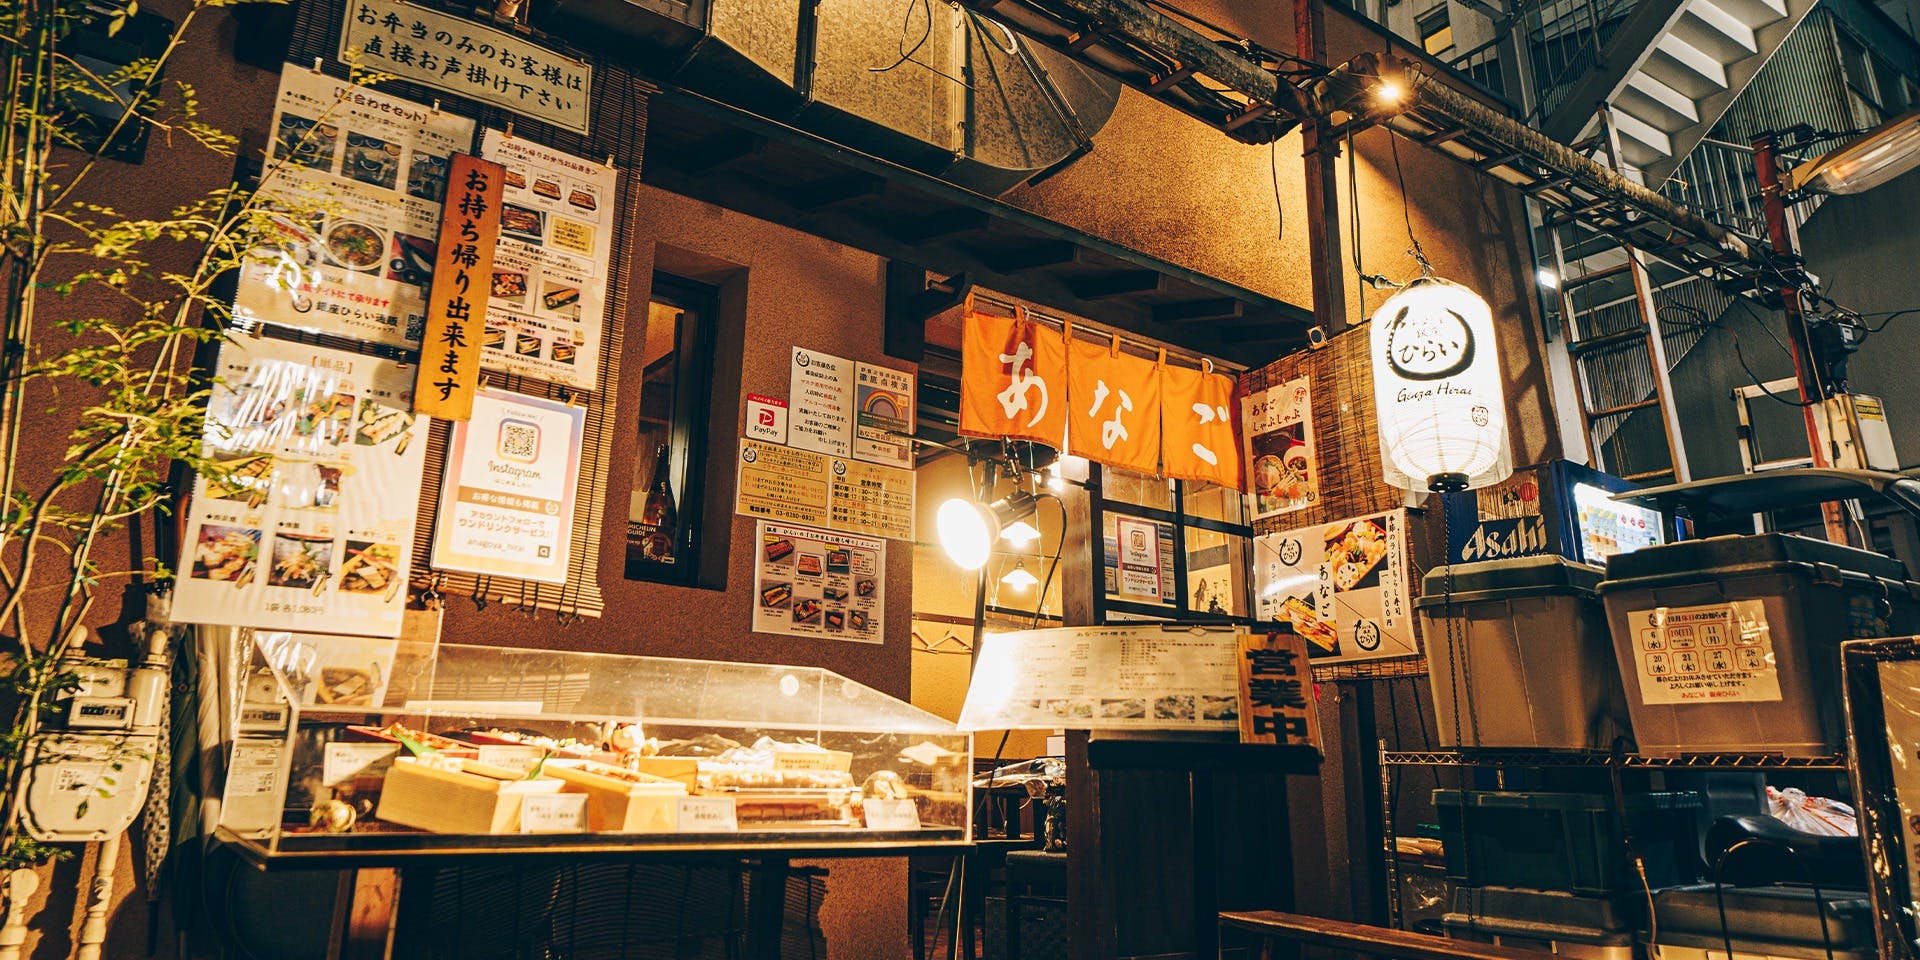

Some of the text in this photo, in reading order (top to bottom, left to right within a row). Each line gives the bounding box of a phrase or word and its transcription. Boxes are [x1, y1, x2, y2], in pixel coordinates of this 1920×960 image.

[357, 4, 582, 92] お弁当のみのお客様は
[363, 35, 573, 111] 直接お声掛け下さい
[433, 168, 488, 401] お持ち帰り出来ます
[298, 283, 390, 307] 販サイトにて承ります
[316, 301, 398, 327] 銀座ひらい通販
[1399, 340, 1459, 364] ひらい
[811, 360, 836, 371] お客様各位
[1396, 382, 1473, 403] Ginza Hirai
[997, 342, 1230, 466] あなご
[1252, 398, 1276, 417] あなご
[1253, 408, 1301, 432] しゃぶしゃぶ
[754, 425, 778, 437] PayPay
[488, 460, 542, 480] Instagram
[860, 480, 882, 489] 営業時間
[470, 510, 546, 527] アカウントフォローで
[627, 523, 657, 533] MICHELIN
[627, 529, 646, 537] GUIDE
[1462, 514, 1547, 561] Asahi
[1319, 564, 1331, 618] あなご
[1667, 611, 1728, 623] 10月休日のお知らせ
[1707, 626, 1716, 634] 11
[1648, 641, 1661, 649] (水)
[1706, 636, 1720, 645] (月)
[1682, 653, 1692, 661] 21
[1713, 651, 1722, 659] 27
[1745, 648, 1756, 657] 28
[1653, 664, 1666, 673] (水)
[1712, 661, 1727, 669] (水)
[1656, 673, 1757, 683] 都合によりお休みさせていただきます。
[1670, 681, 1746, 690] よろしくお願い申し上げます。
[1245, 648, 1308, 744] 営業中
